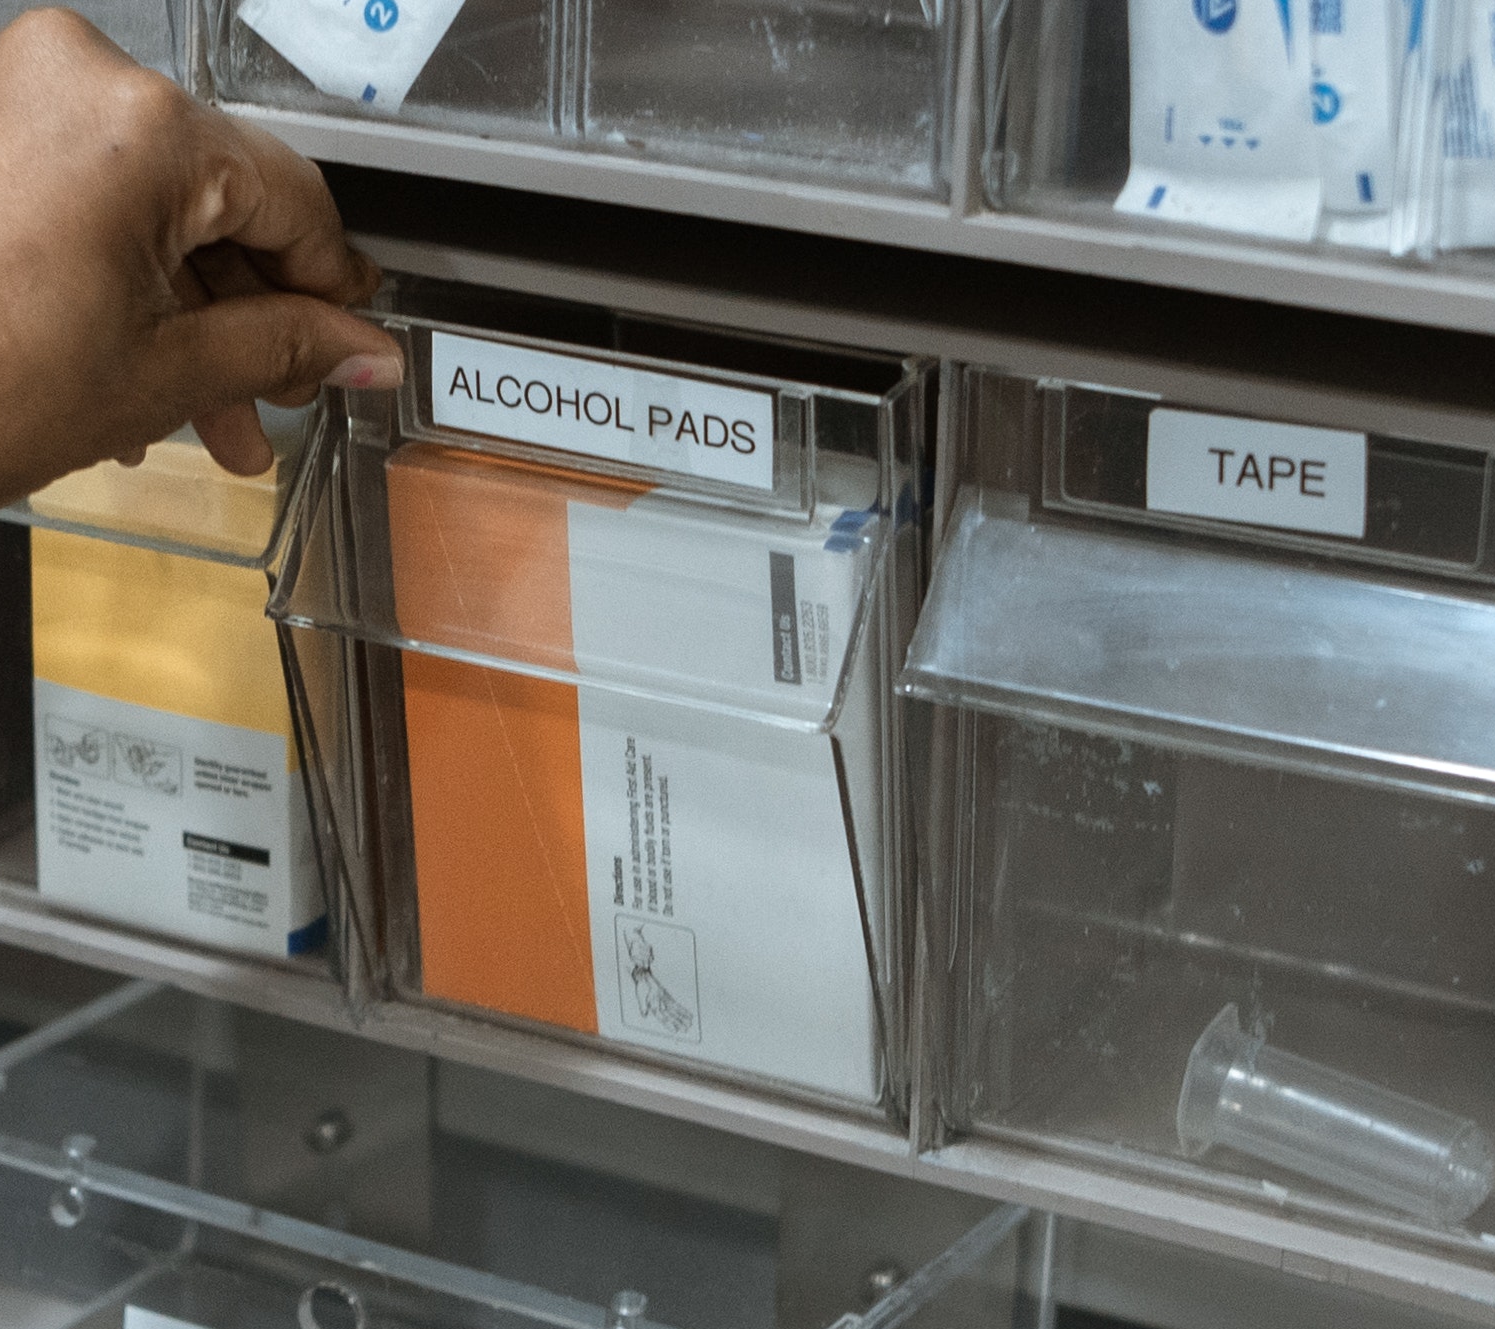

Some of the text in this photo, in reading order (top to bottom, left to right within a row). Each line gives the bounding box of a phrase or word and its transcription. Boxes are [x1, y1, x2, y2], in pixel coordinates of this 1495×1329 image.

[447, 365, 757, 456] ALCOHOL PADS
[1209, 448, 1328, 499] TAPE
[781, 631, 794, 681] Contact
[614, 856, 625, 906] Directions
